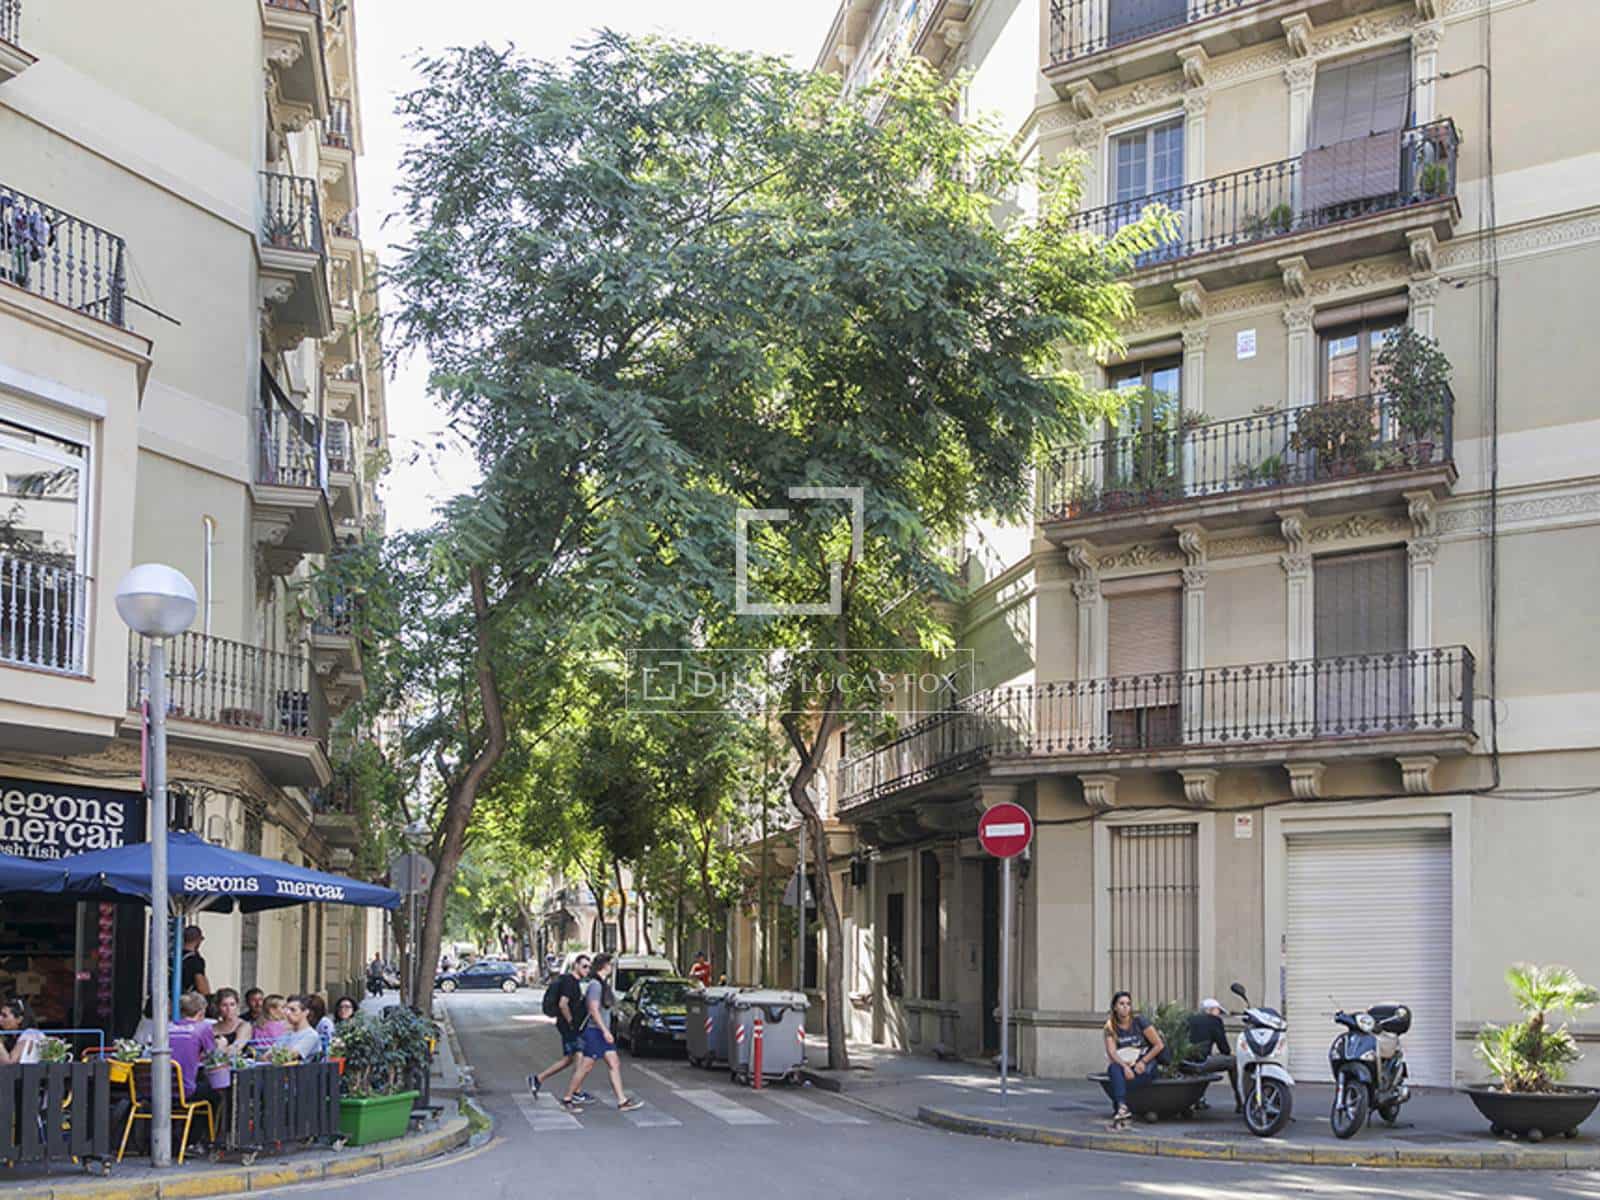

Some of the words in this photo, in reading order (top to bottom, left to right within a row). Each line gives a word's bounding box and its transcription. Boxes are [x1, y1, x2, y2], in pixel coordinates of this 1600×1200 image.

[0, 789, 125, 827] egons
[27, 844, 61, 860] fish
[183, 875, 259, 892] segons
